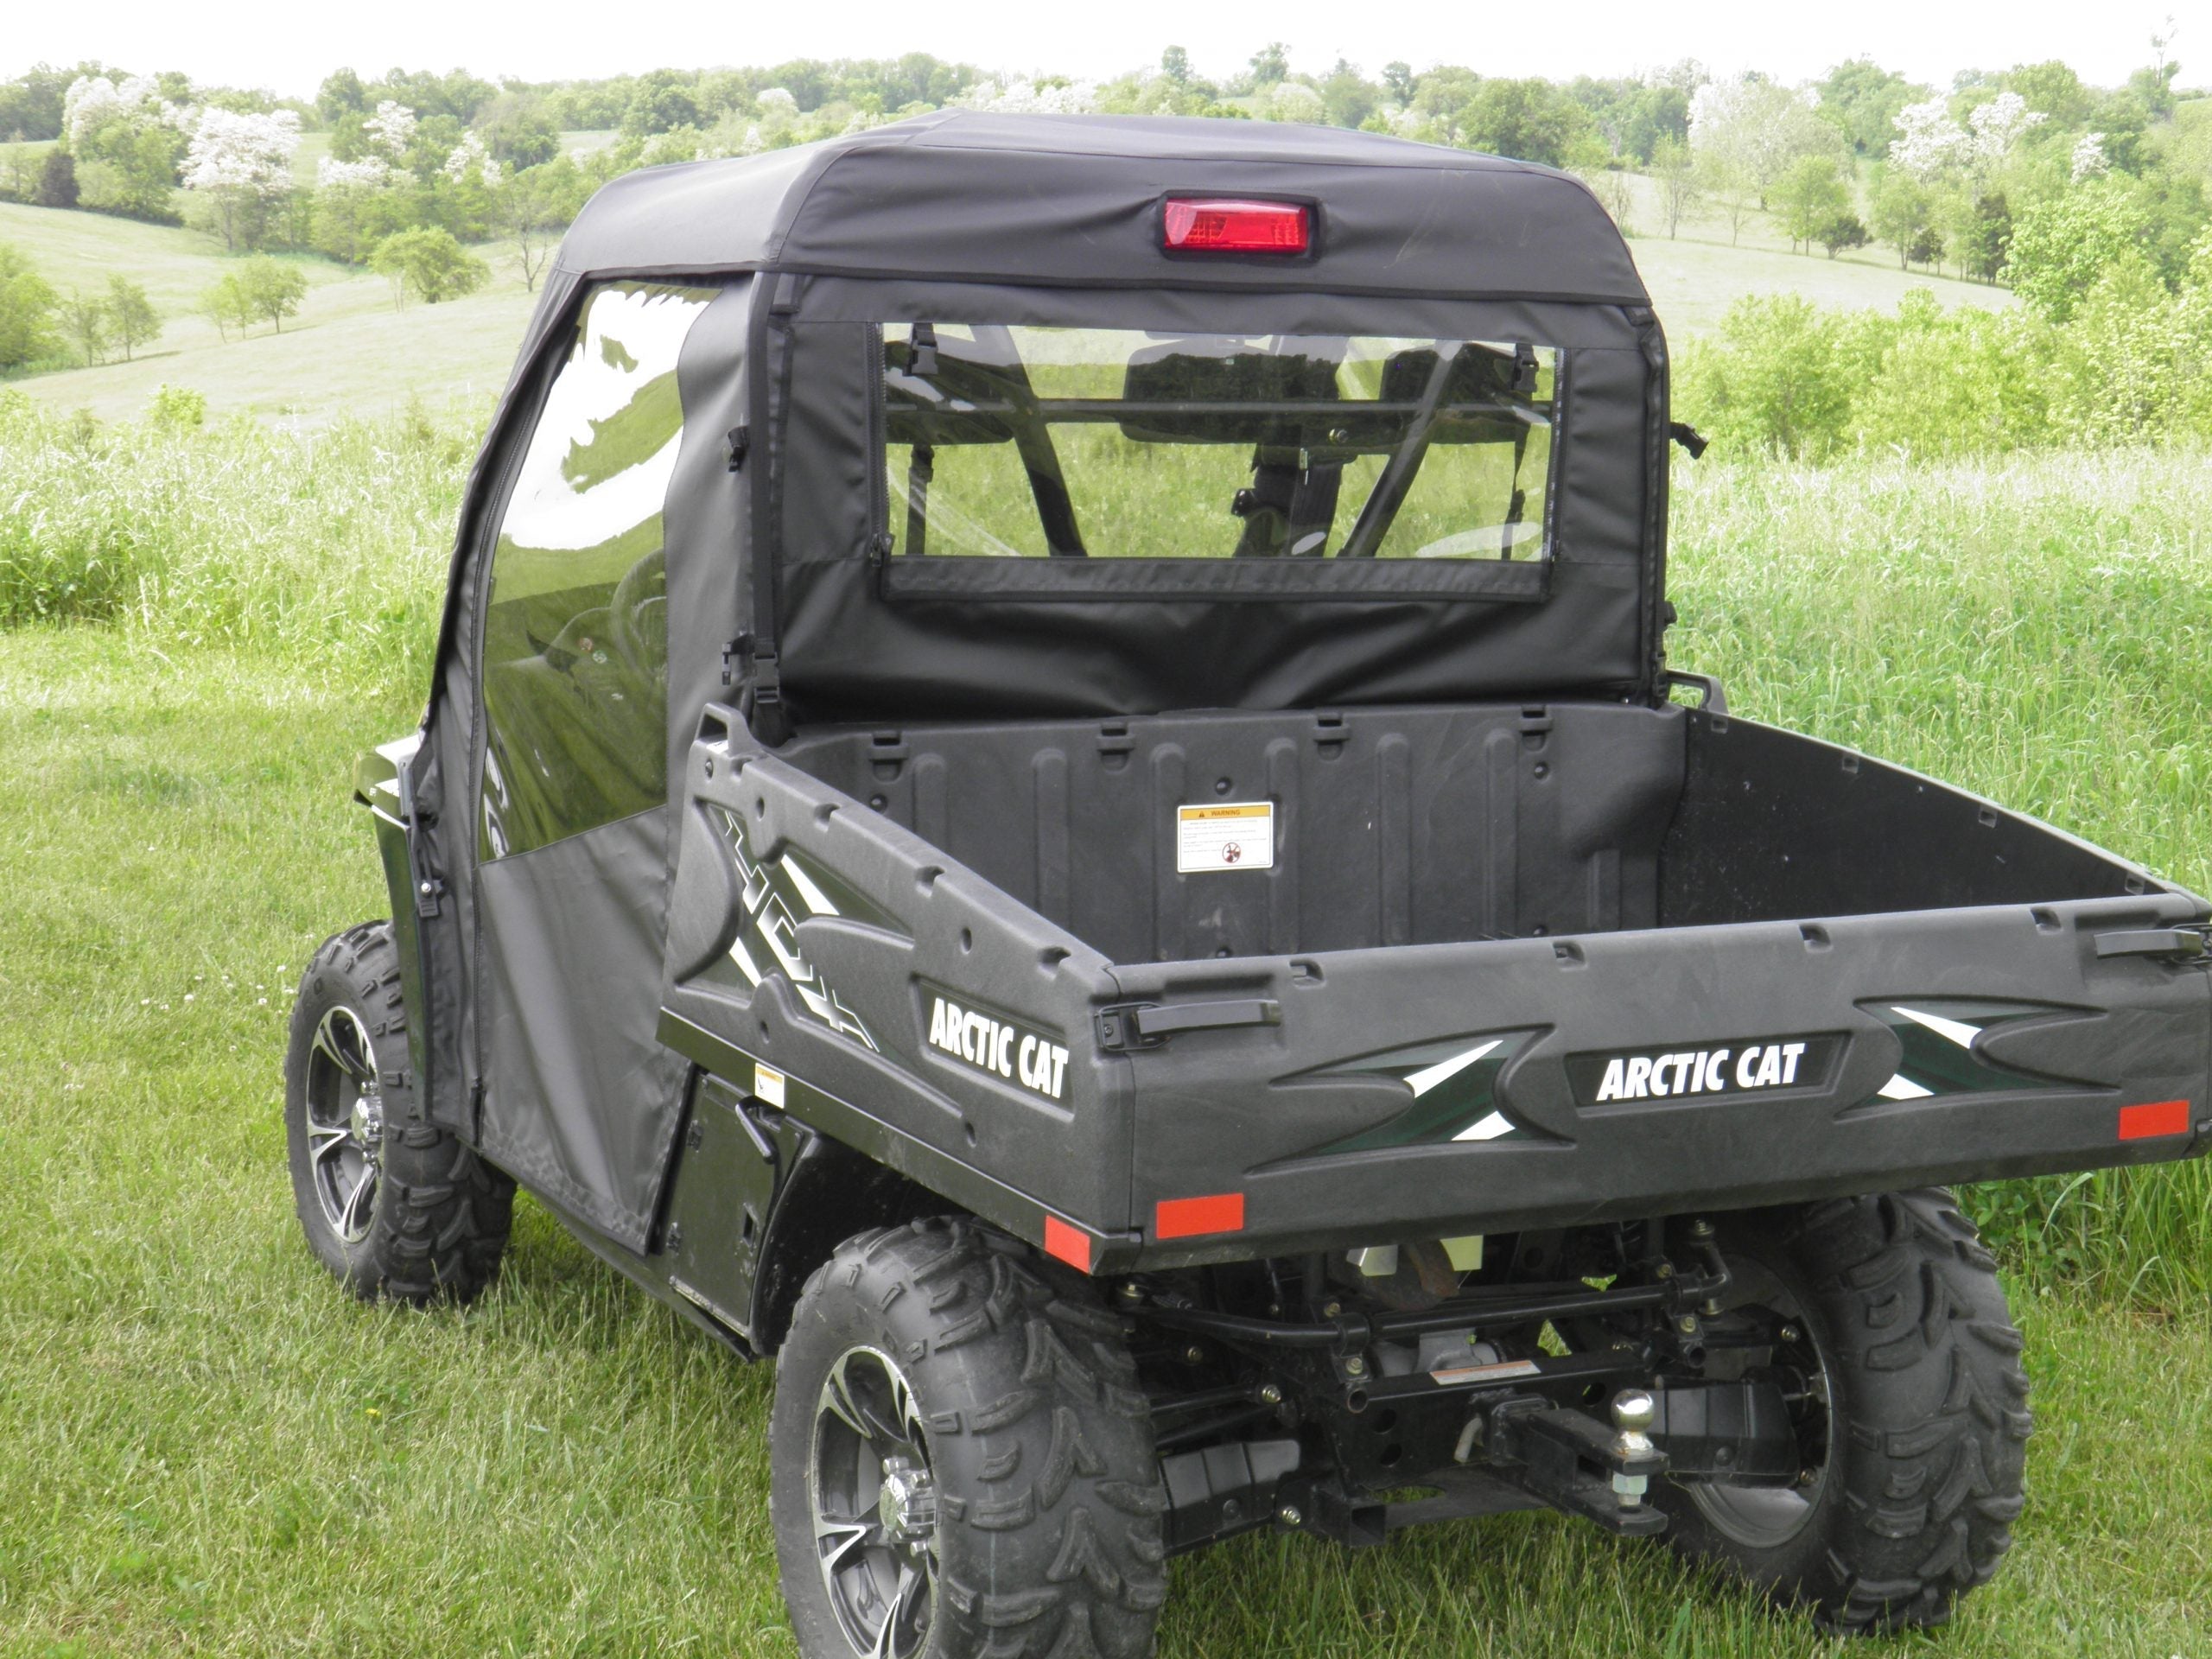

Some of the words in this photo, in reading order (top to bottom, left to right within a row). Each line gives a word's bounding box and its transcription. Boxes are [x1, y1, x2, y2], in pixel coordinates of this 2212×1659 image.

[929, 997, 1014, 1077] ARCTIC
[1019, 1034, 1069, 1099] CAT
[1596, 1049, 1730, 1102] ARCTIC
[1736, 1043, 1806, 1088] CAT
